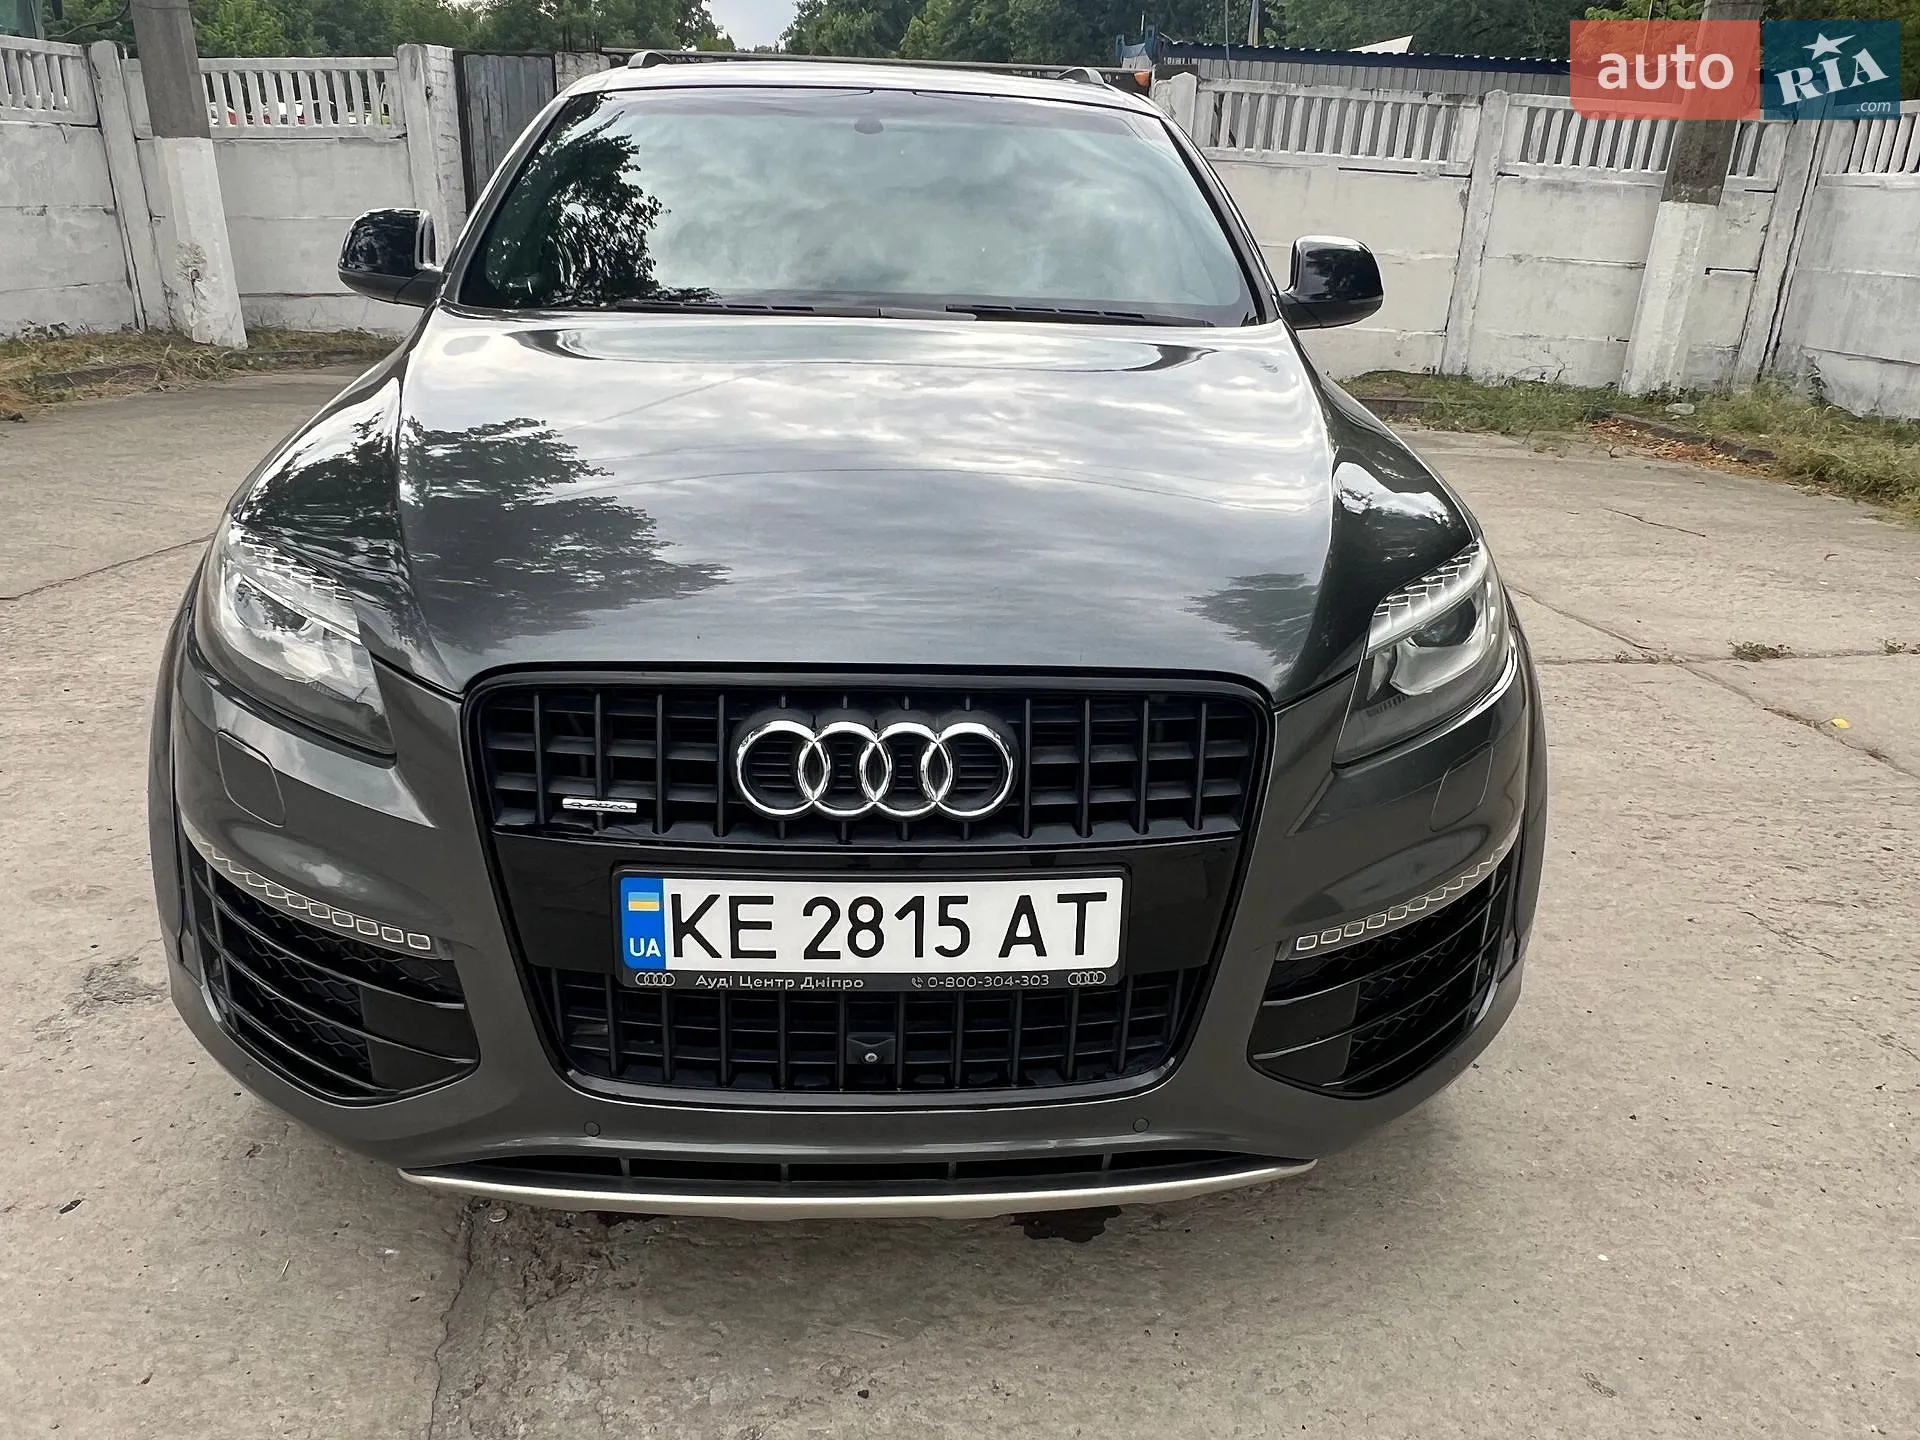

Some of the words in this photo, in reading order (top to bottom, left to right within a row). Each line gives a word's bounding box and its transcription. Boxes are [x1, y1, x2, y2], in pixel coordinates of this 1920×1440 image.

[671, 893, 777, 961] KE
[802, 895, 971, 960] 2815
[998, 892, 1108, 958] AT
[629, 938, 662, 958] UA
[695, 974, 733, 989] Ауді
[739, 975, 795, 990] Центр
[800, 976, 865, 990] Дніпро
[927, 974, 1050, 988] 0-800-304-303
